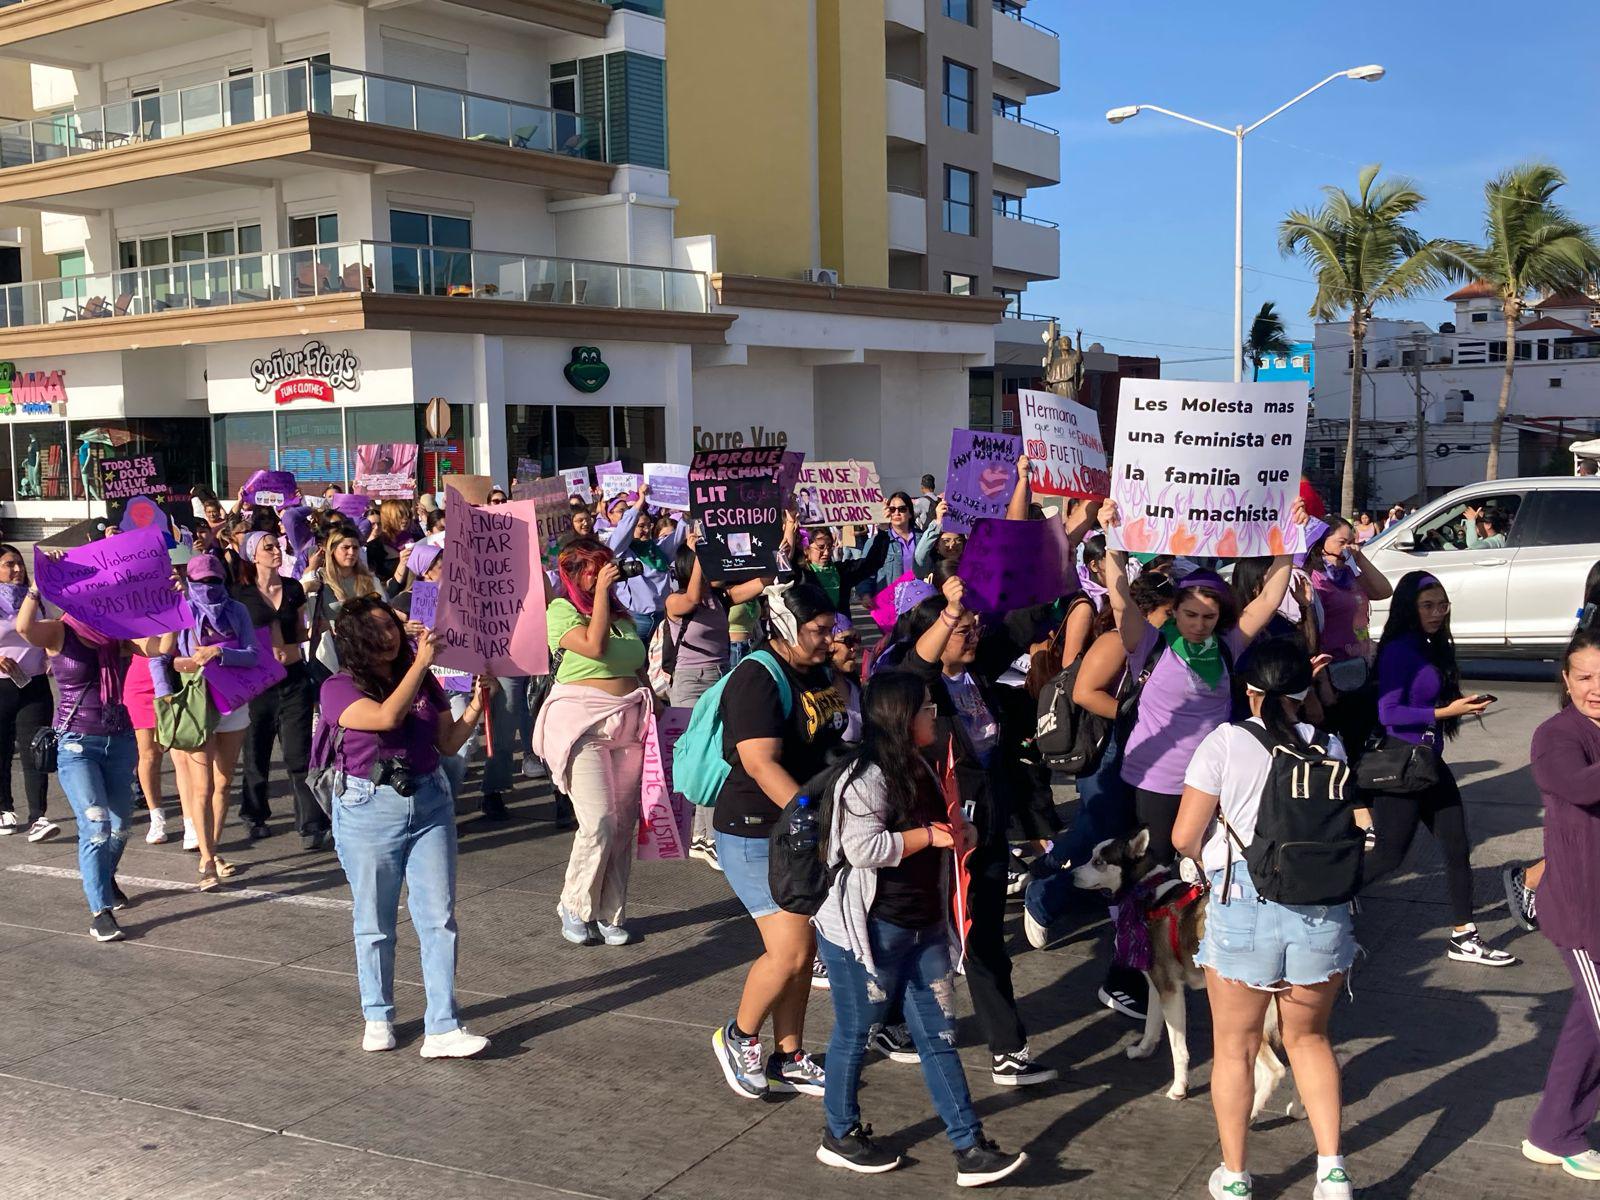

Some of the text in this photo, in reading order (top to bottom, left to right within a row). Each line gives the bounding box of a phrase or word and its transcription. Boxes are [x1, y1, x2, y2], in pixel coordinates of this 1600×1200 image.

[280, 385, 294, 398] FUN
[298, 383, 323, 396] CLOTHES
[1025, 394, 1077, 426] Hermana
[1134, 397, 1294, 413] Les Molesta mas
[751, 426, 788, 448] Vue
[1054, 426, 1064, 435] NO
[1128, 430, 1292, 447] una feminista en
[1027, 439, 1047, 460] NO
[1050, 444, 1070, 463] FUE
[1070, 447, 1084, 466] TU
[102, 457, 154, 471] TODO ESE
[120, 466, 157, 480] DOLOR
[819, 468, 834, 483] NO
[836, 468, 853, 483] SE
[1125, 464, 1289, 486] la familia que
[105, 478, 148, 491] VUELVE
[105, 484, 167, 499] MULTIPLICADO
[696, 486, 727, 504] LIT
[819, 488, 883, 505] ROBEN MIS
[705, 507, 777, 527] ESCRIBIO
[825, 506, 872, 522] LOGROS
[1145, 504, 1278, 522] un machista
[449, 562, 467, 585] LAS
[484, 557, 512, 577] QUE
[450, 585, 463, 607] DE
[446, 628, 469, 648] QUE
